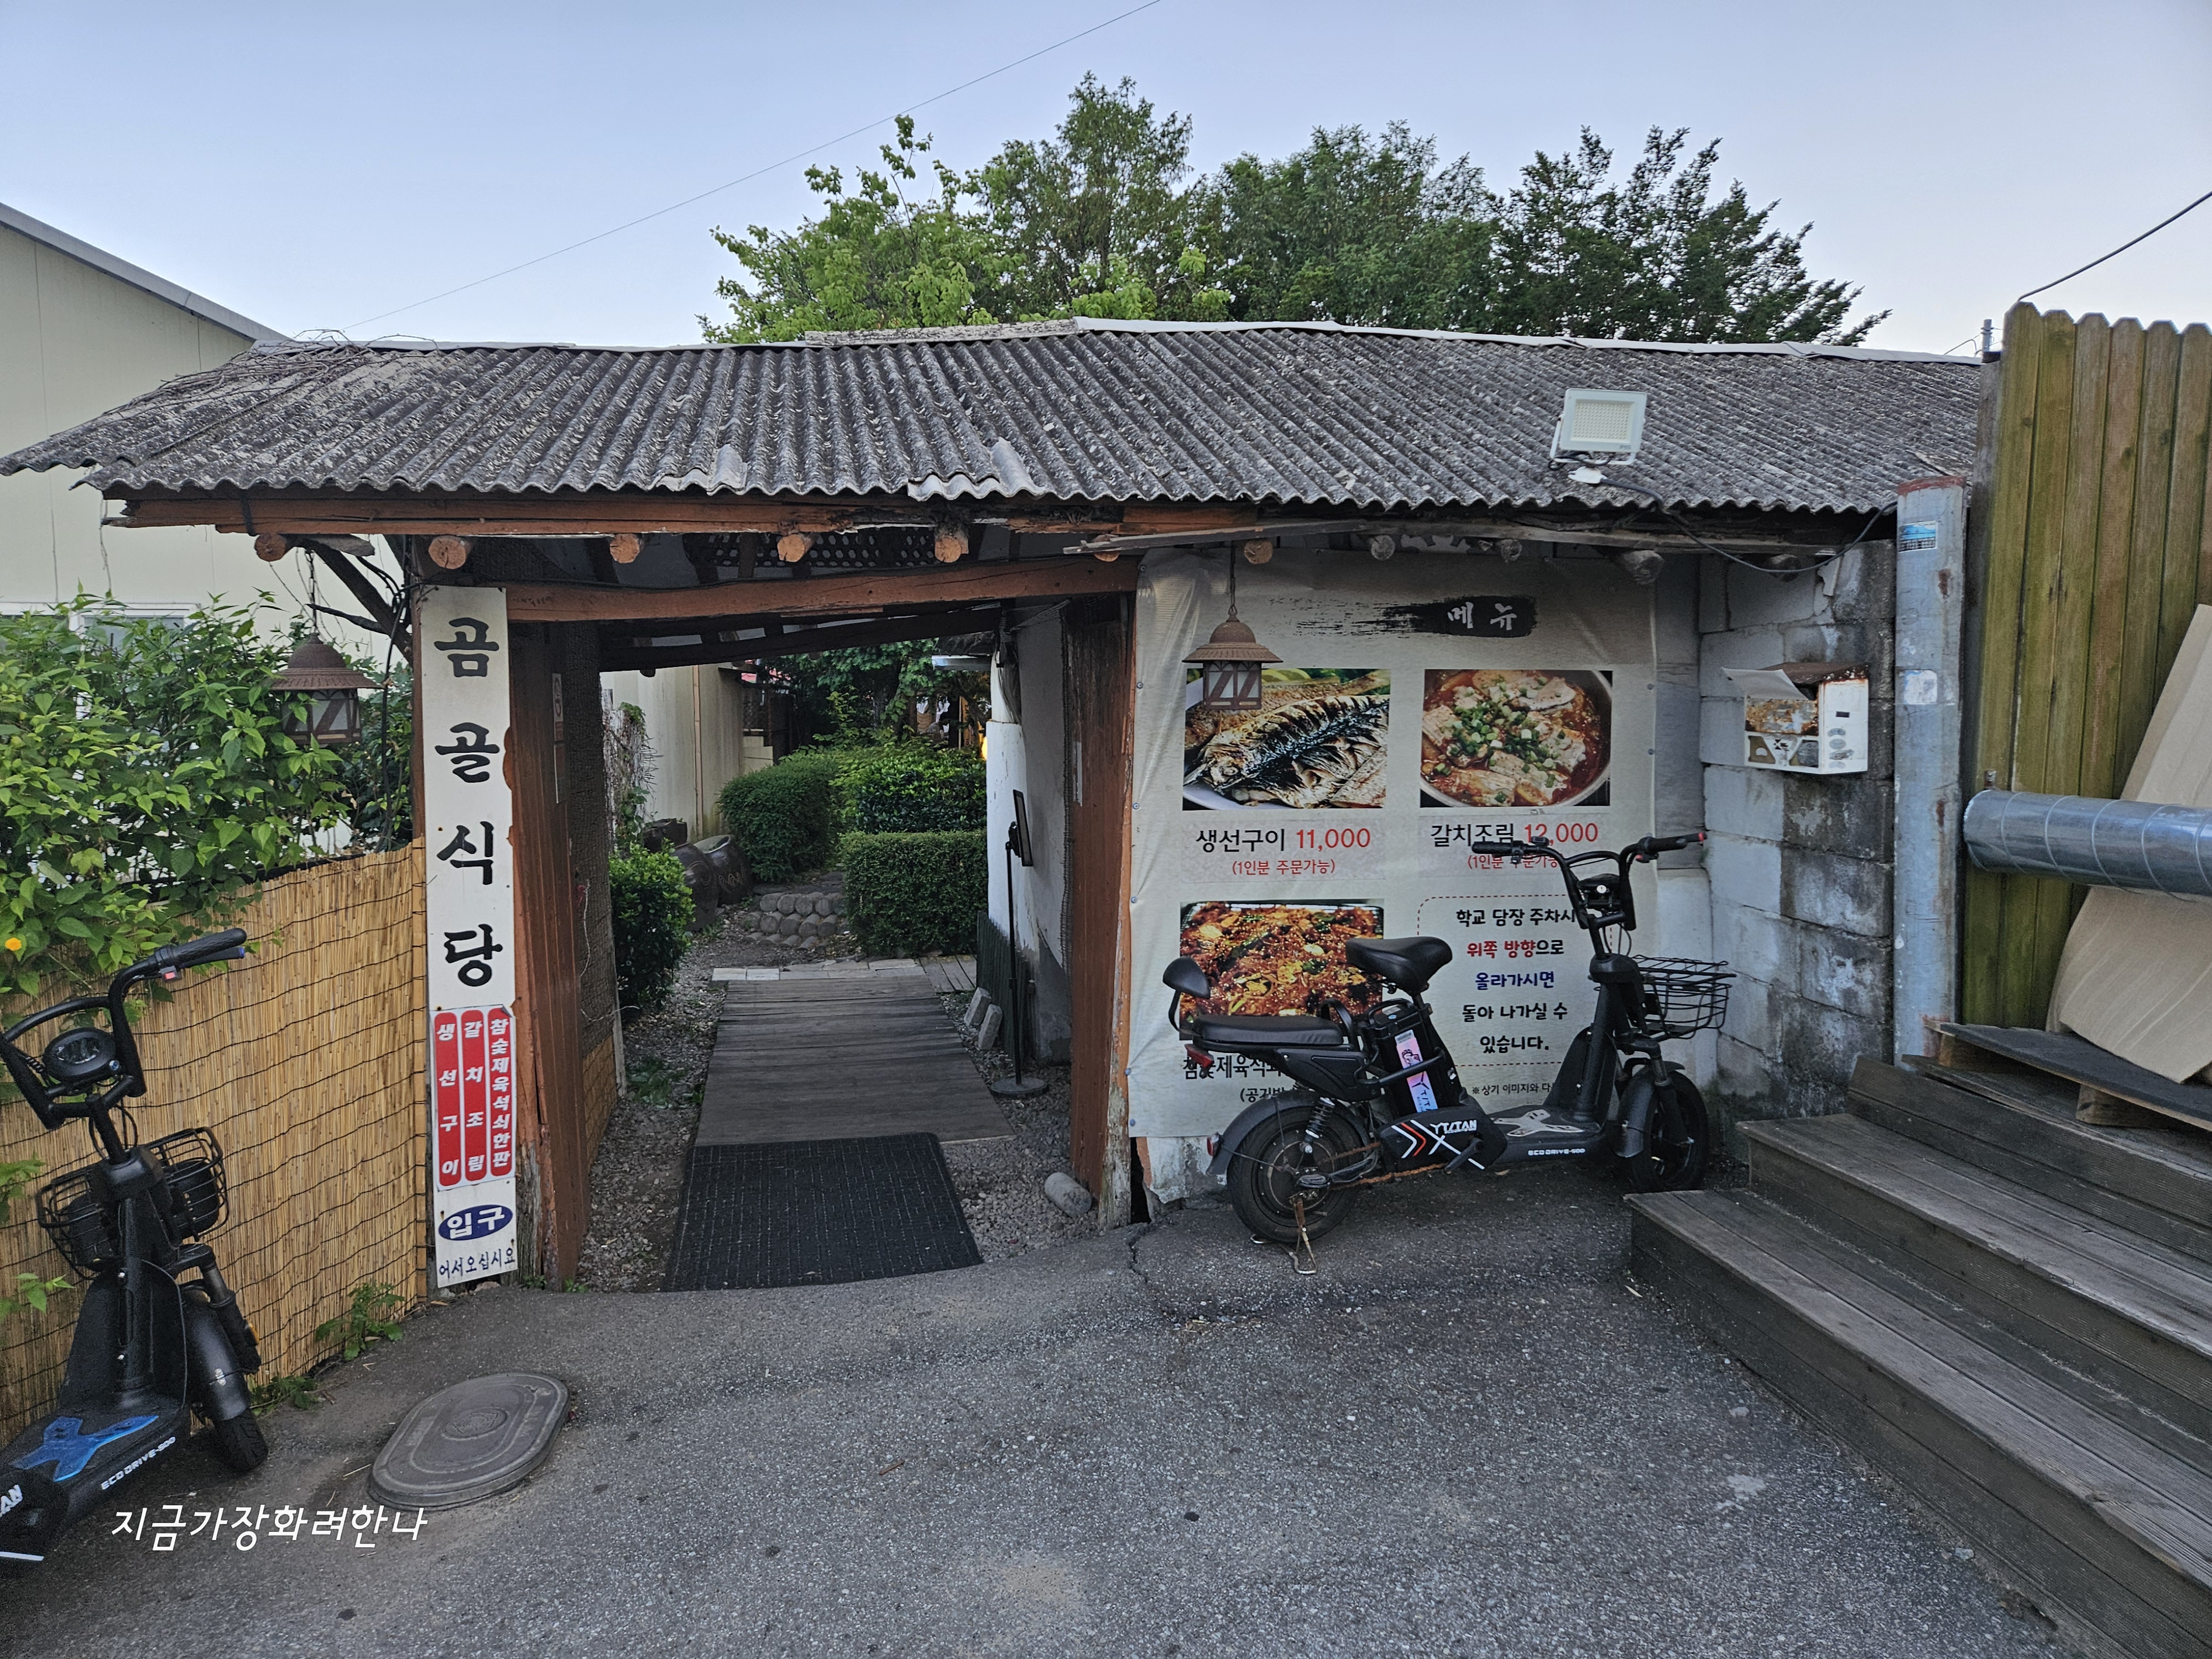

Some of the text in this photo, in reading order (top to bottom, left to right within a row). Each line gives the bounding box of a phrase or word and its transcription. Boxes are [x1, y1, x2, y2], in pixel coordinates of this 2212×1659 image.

[1447, 601, 1517, 631] 메뉴
[434, 617, 503, 988] 곰골식당
[1196, 828, 1370, 853] 생선구이 11,000
[1430, 823, 1599, 847] 갈치조림 12,000
[1232, 858, 1335, 875] (1인분 주문가능)
[1456, 909, 1575, 927] 학교 담장 주차시
[1467, 940, 1564, 959] 위쪽 방향으로
[1475, 971, 1554, 990] 올라가시면
[1462, 1002, 1568, 1022] 돌아 나가실 수
[1480, 1035, 1550, 1054] 있습니다.
[436, 1024, 460, 1176] 생선구이
[463, 1020, 486, 1172] 갈치조림
[1502, 1083, 1540, 1094] 이미지와
[447, 1207, 505, 1239] 입구
[439, 1247, 515, 1279] 어서오십시요
